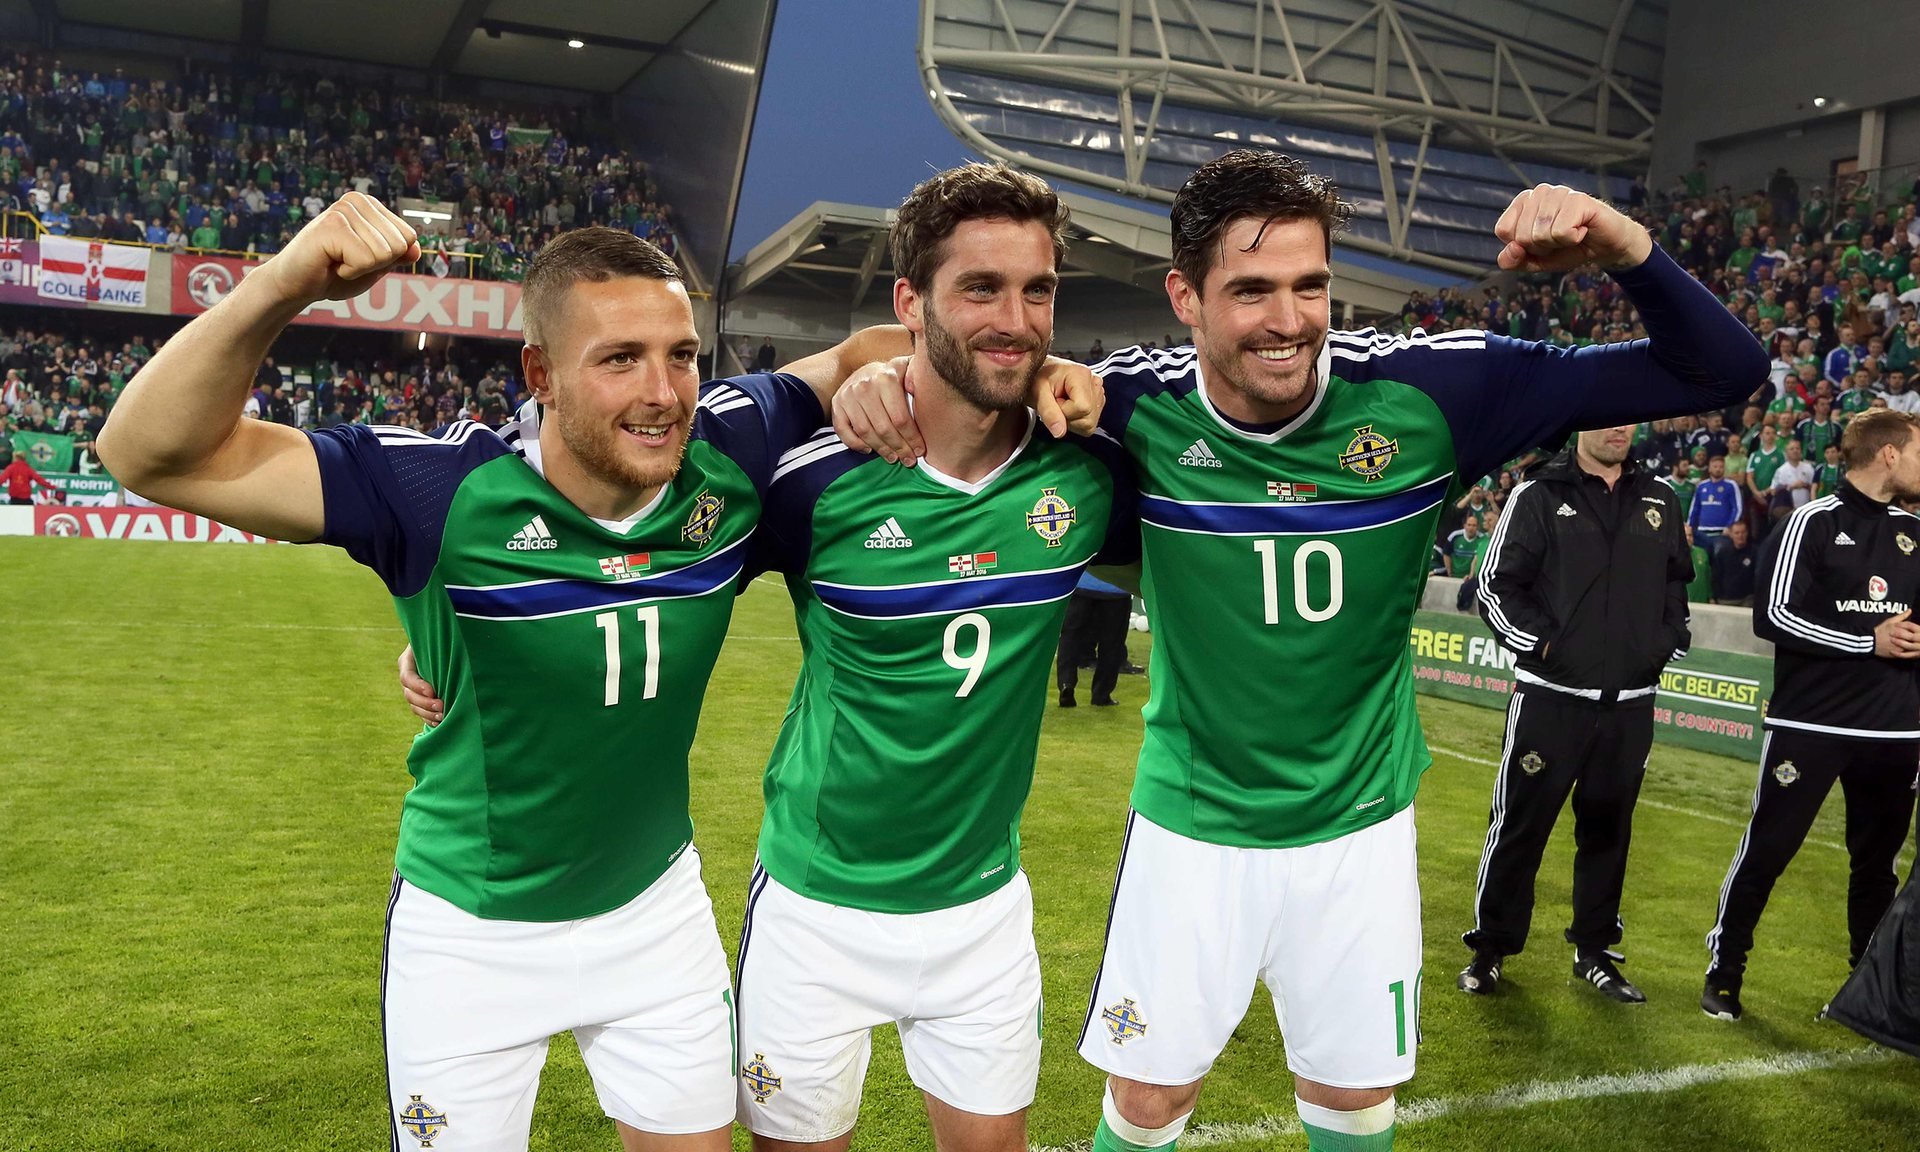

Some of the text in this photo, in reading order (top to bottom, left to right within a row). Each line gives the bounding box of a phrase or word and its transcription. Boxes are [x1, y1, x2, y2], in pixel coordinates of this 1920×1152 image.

[43, 280, 142, 303] COLERAINE
[1178, 456, 1223, 468] adidas
[70, 479, 113, 490] NORTH
[506, 538, 558, 550] adidas
[864, 537, 913, 549] adidas
[1253, 539, 1344, 625] 10
[595, 605, 661, 707] 11
[942, 612, 991, 698] 9
[1410, 627, 1464, 662] FREE
[1443, 669, 1471, 686] FANS
[1473, 675, 1482, 688] &
[1485, 677, 1508, 692] THE
[1685, 676, 1759, 704] BELFAST
[1675, 711, 1754, 740] COUNTRY!
